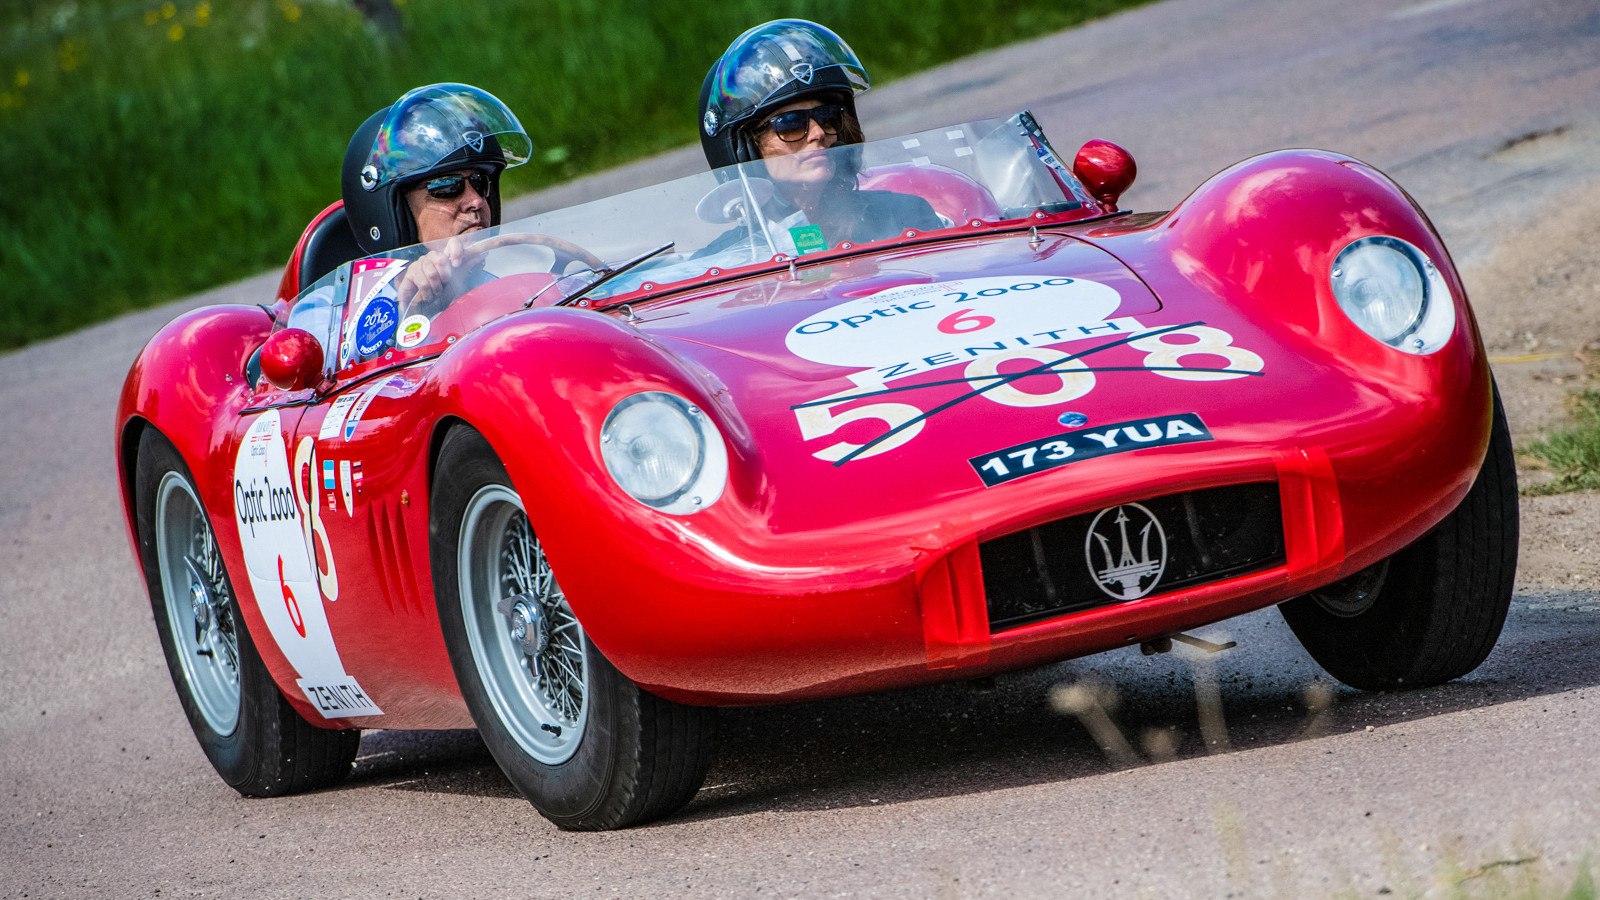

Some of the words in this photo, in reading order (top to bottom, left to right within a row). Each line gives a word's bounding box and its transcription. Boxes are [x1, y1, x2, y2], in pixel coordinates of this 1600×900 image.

[363, 311, 390, 328] 2015
[795, 298, 936, 335] Optic
[953, 277, 1075, 304] 2000
[936, 308, 996, 335] 6
[878, 321, 1122, 380] ZENITH
[793, 324, 1265, 462] 508
[981, 440, 1076, 478] 173
[1084, 412, 1204, 450] YUA
[235, 477, 268, 538] Optic
[264, 476, 296, 522] 2000
[277, 553, 307, 639] 6
[308, 684, 372, 711] ZENITH
